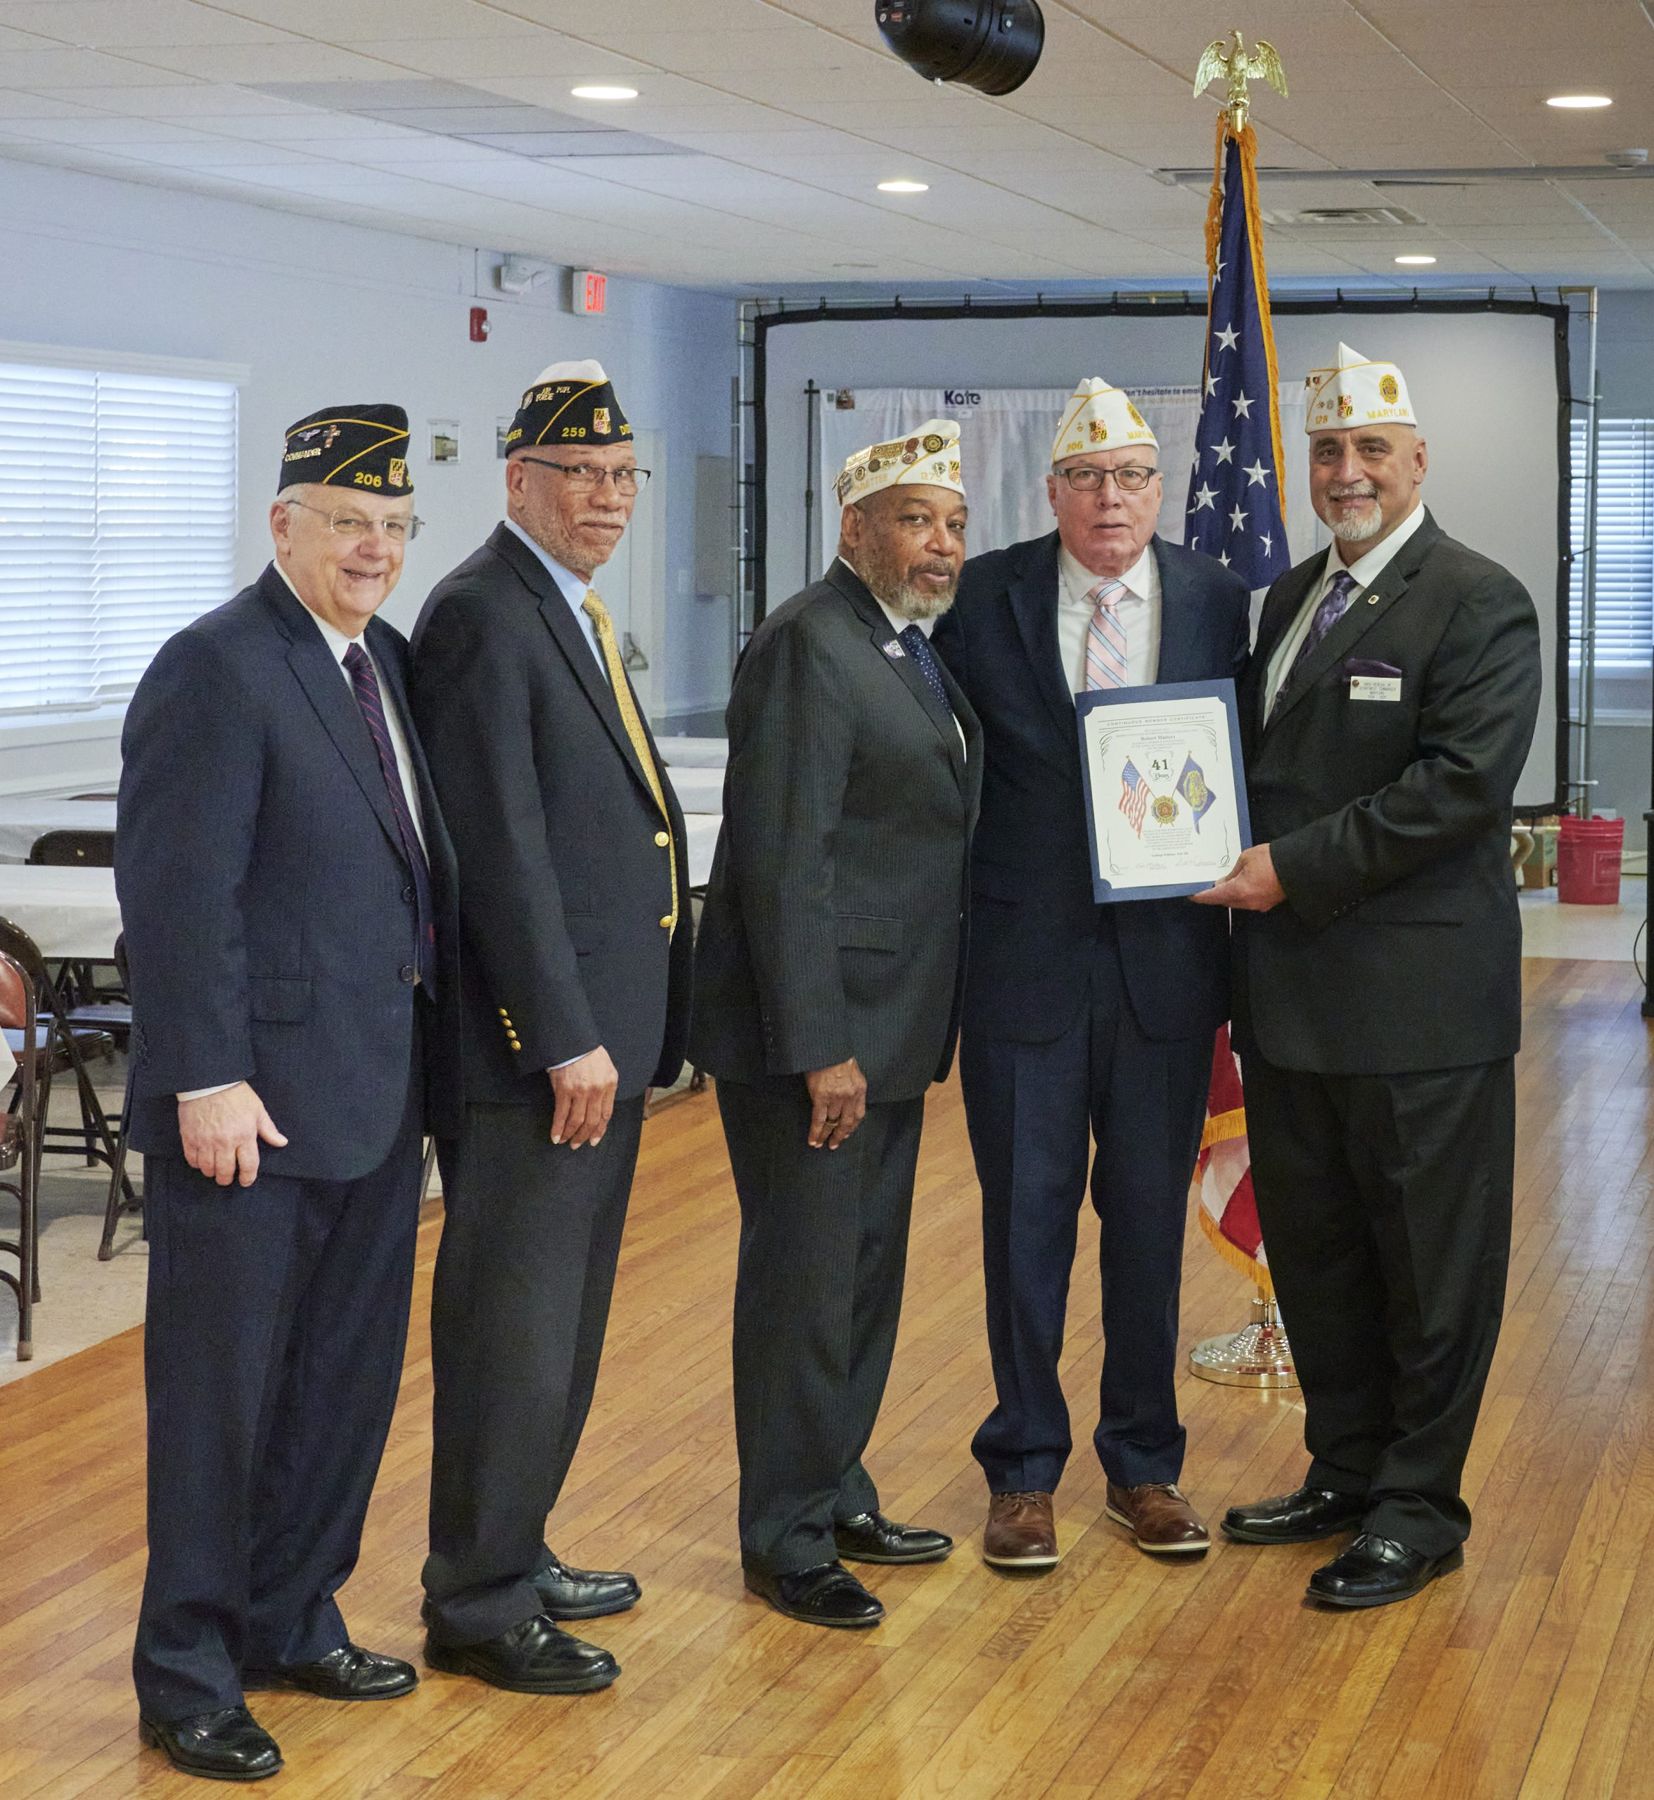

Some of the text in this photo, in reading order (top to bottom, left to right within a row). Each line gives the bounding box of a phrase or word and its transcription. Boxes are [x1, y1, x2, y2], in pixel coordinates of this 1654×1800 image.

[584, 273, 606, 313] EXIT
[944, 389, 981, 405] Kate
[561, 427, 586, 438] 259
[354, 472, 382, 487] 206
[1152, 759, 1169, 771] 41
